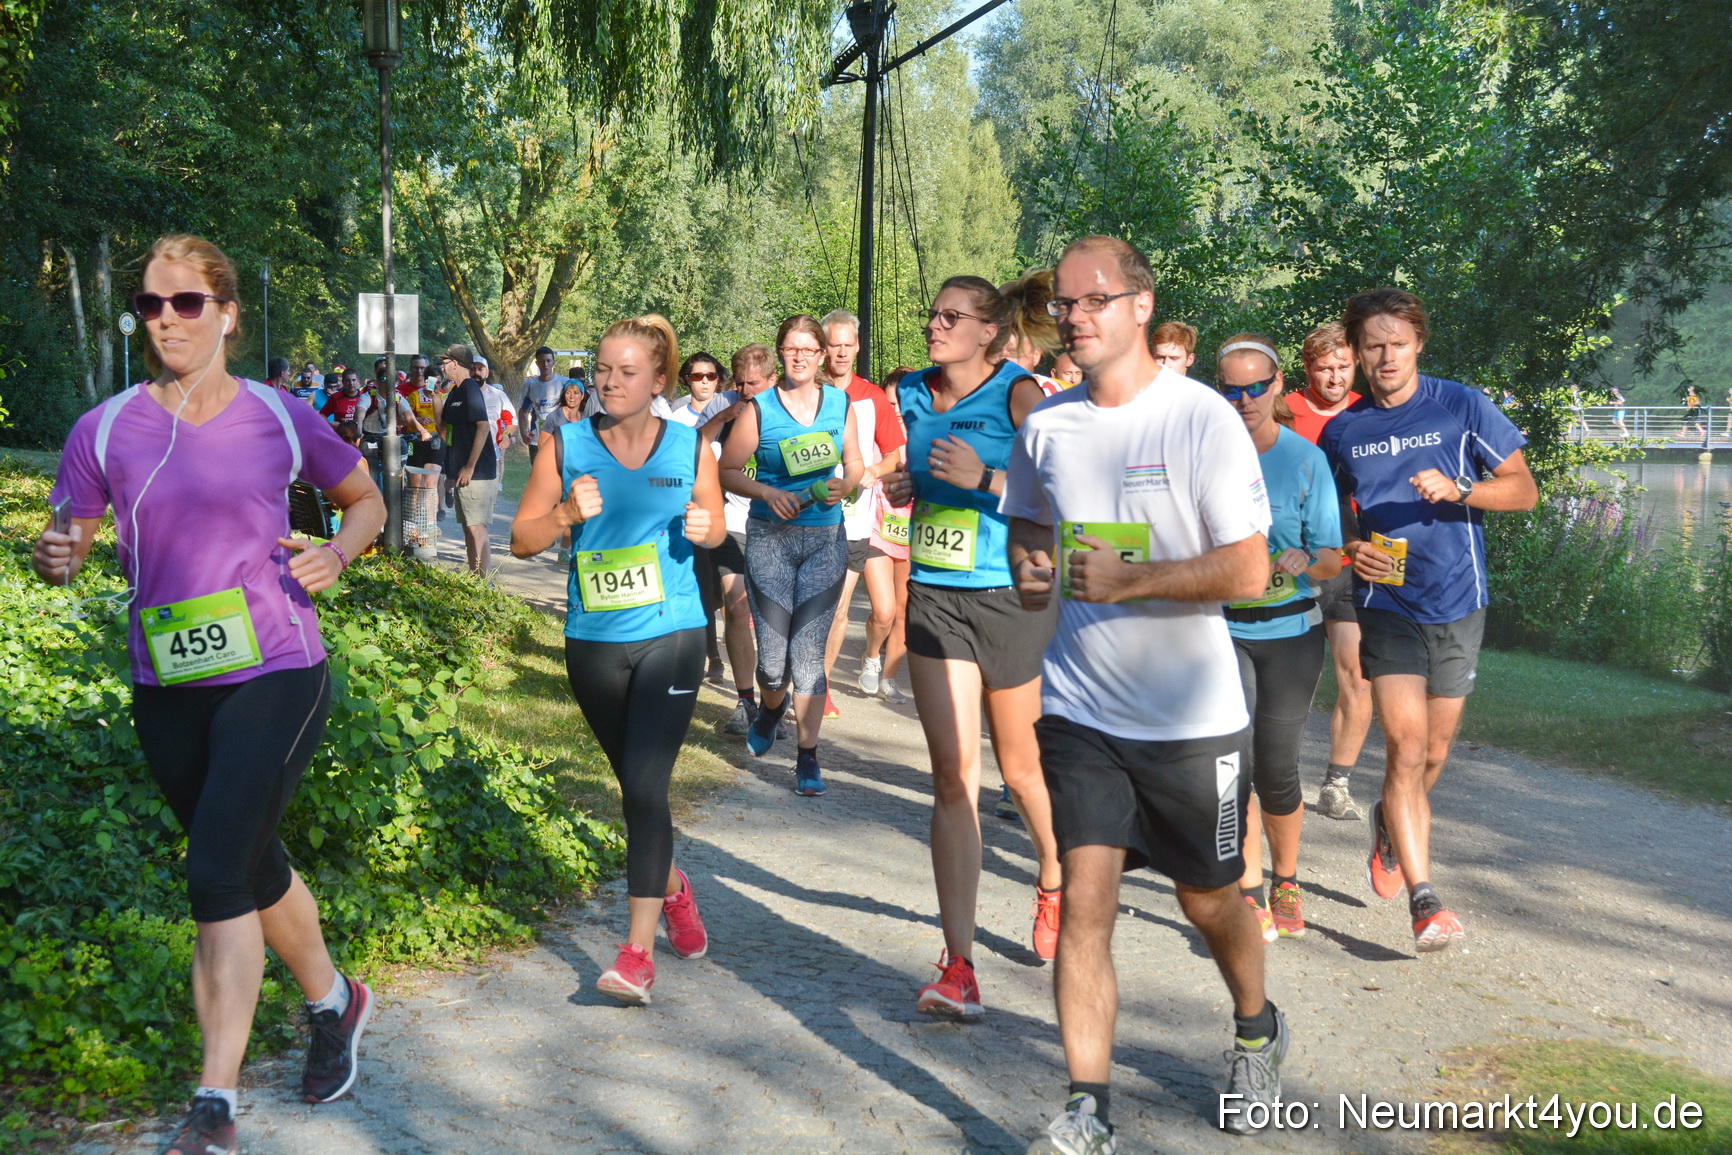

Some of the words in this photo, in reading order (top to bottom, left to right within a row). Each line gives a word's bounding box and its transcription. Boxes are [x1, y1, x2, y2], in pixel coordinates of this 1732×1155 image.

[950, 421, 986, 431] THULE
[791, 443, 831, 464] 1943
[1351, 441, 1389, 458] EURO
[1401, 431, 1441, 450] POLES
[647, 477, 683, 488] THULE
[916, 522, 965, 551] 1942
[590, 566, 648, 594] 1941
[170, 623, 227, 659] 459
[172, 655, 215, 670] Botzenhart
[216, 650, 236, 661] Caro
[1218, 798, 1236, 855] PUMA
